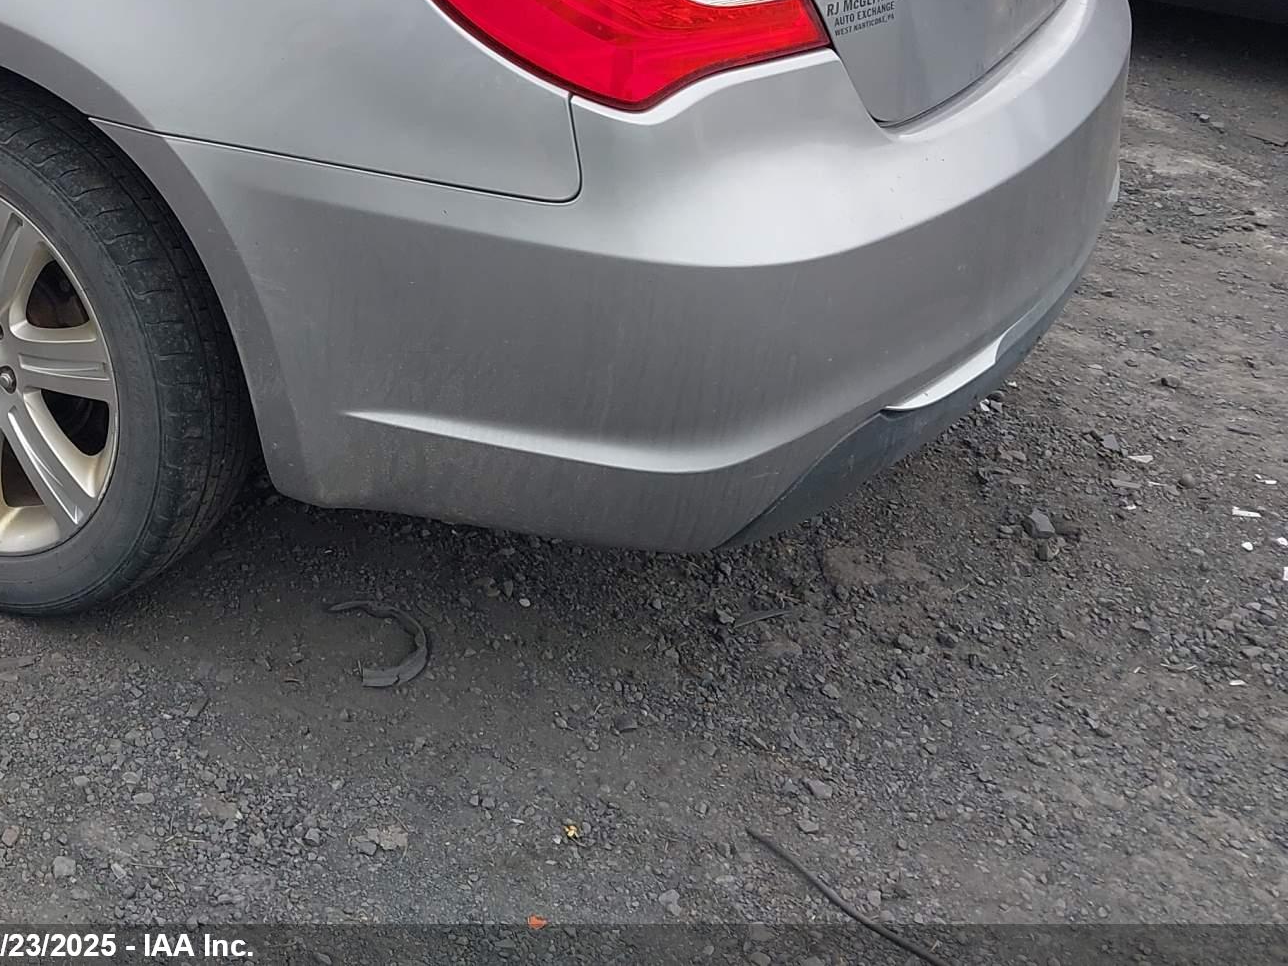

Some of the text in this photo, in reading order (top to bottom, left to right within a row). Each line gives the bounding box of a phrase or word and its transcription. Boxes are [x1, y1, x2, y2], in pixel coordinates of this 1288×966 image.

[826, 1, 840, 17] RJ
[834, 0, 896, 27] AUTO EXCHANGE
[834, 26, 852, 36] WEST
